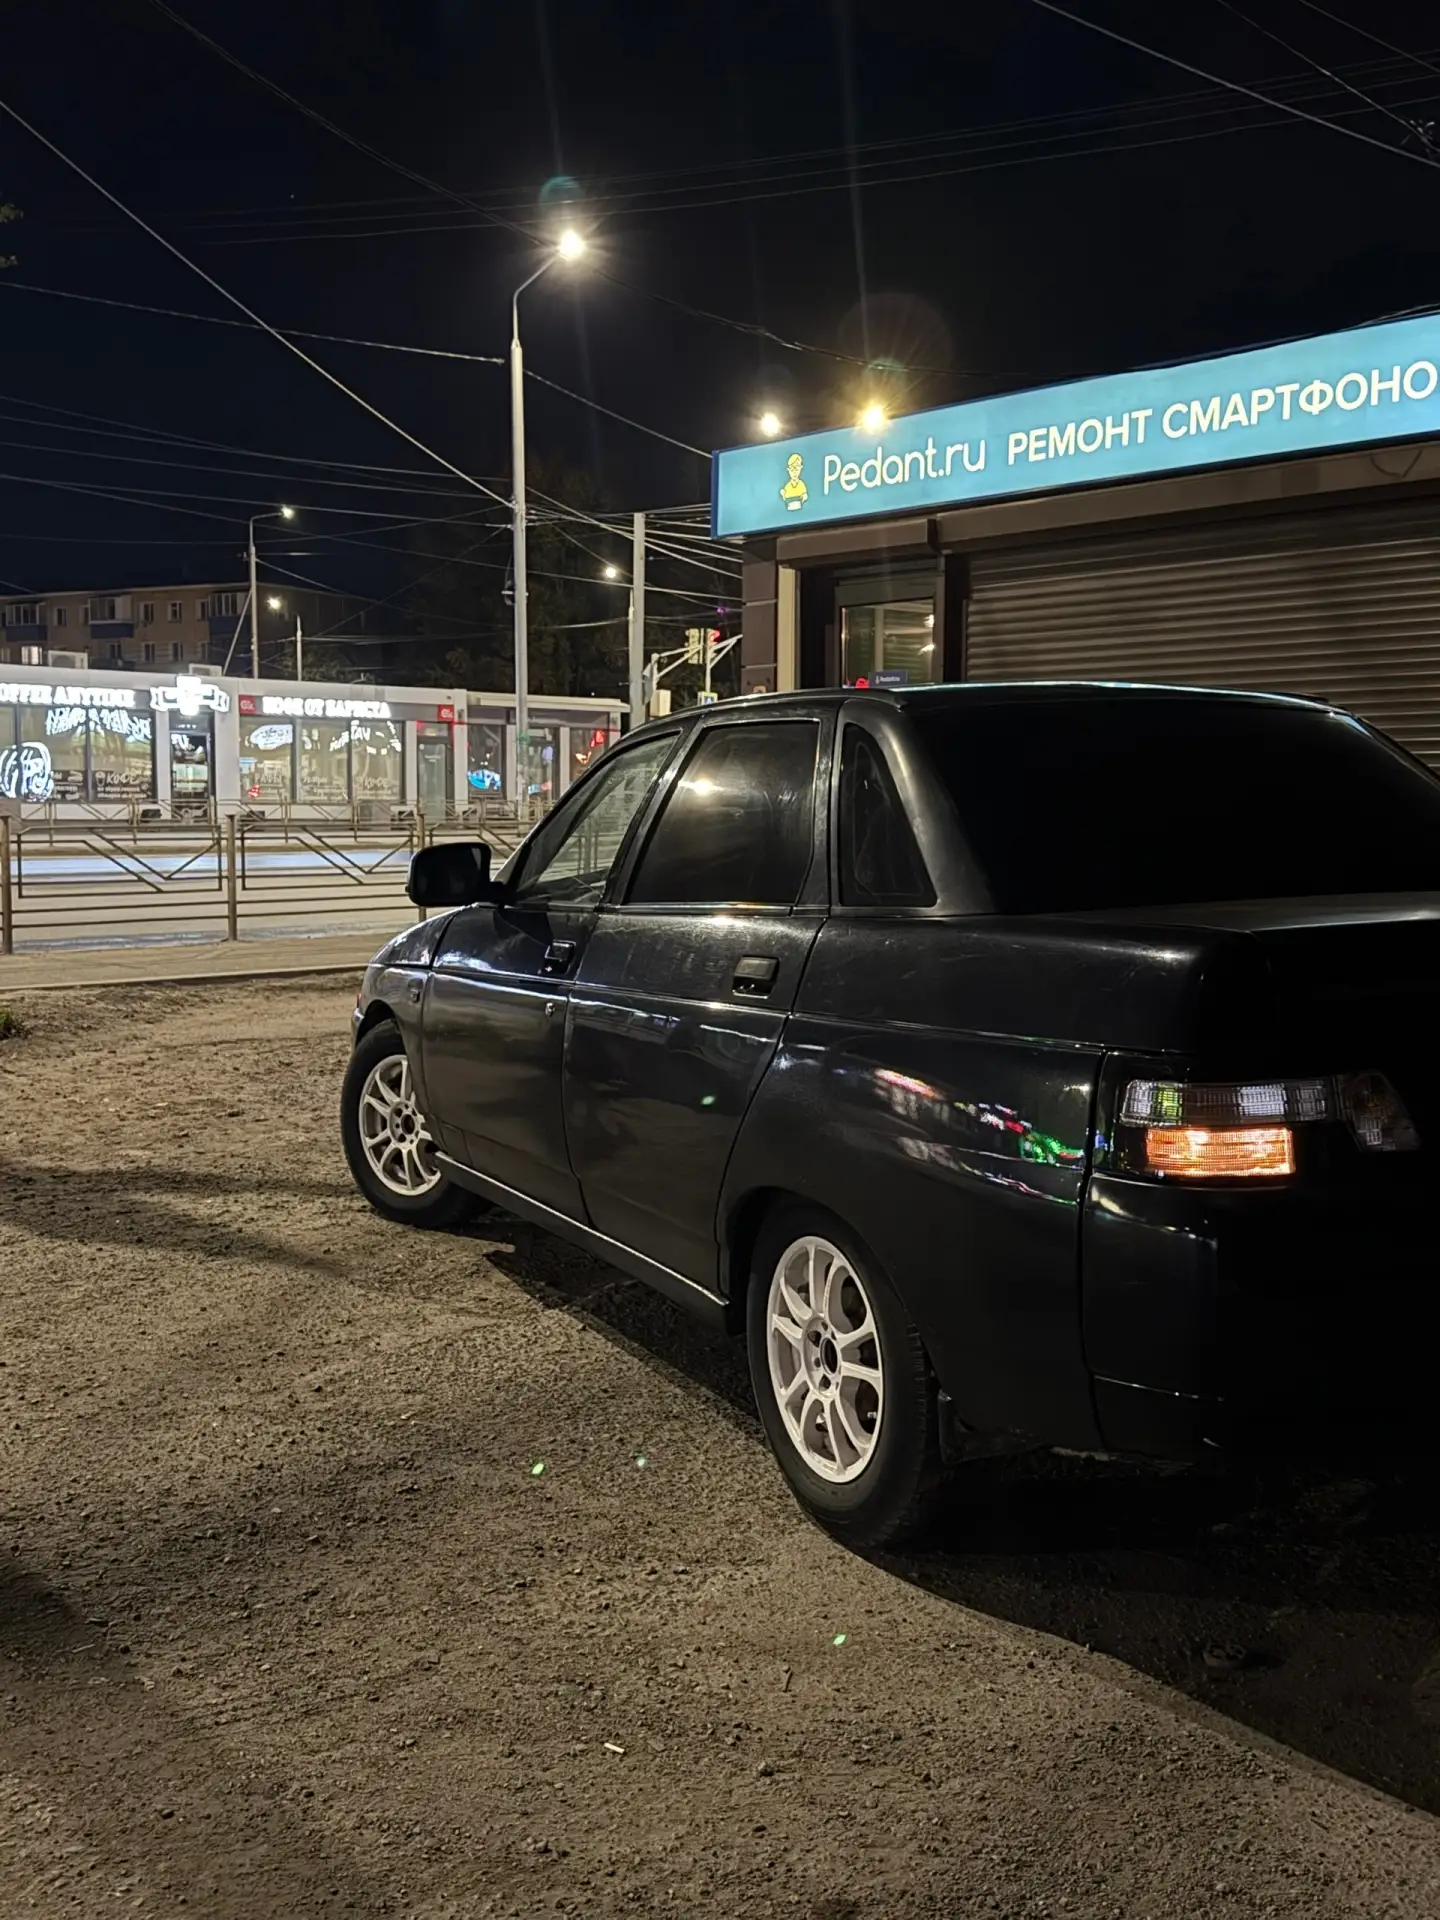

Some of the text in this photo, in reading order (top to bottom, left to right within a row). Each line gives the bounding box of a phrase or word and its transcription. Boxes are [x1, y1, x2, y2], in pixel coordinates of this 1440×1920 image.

[1007, 360, 1438, 465] РЕМОНТ СМАРТФОНО
[823, 437, 985, 494] Pedant.ru
